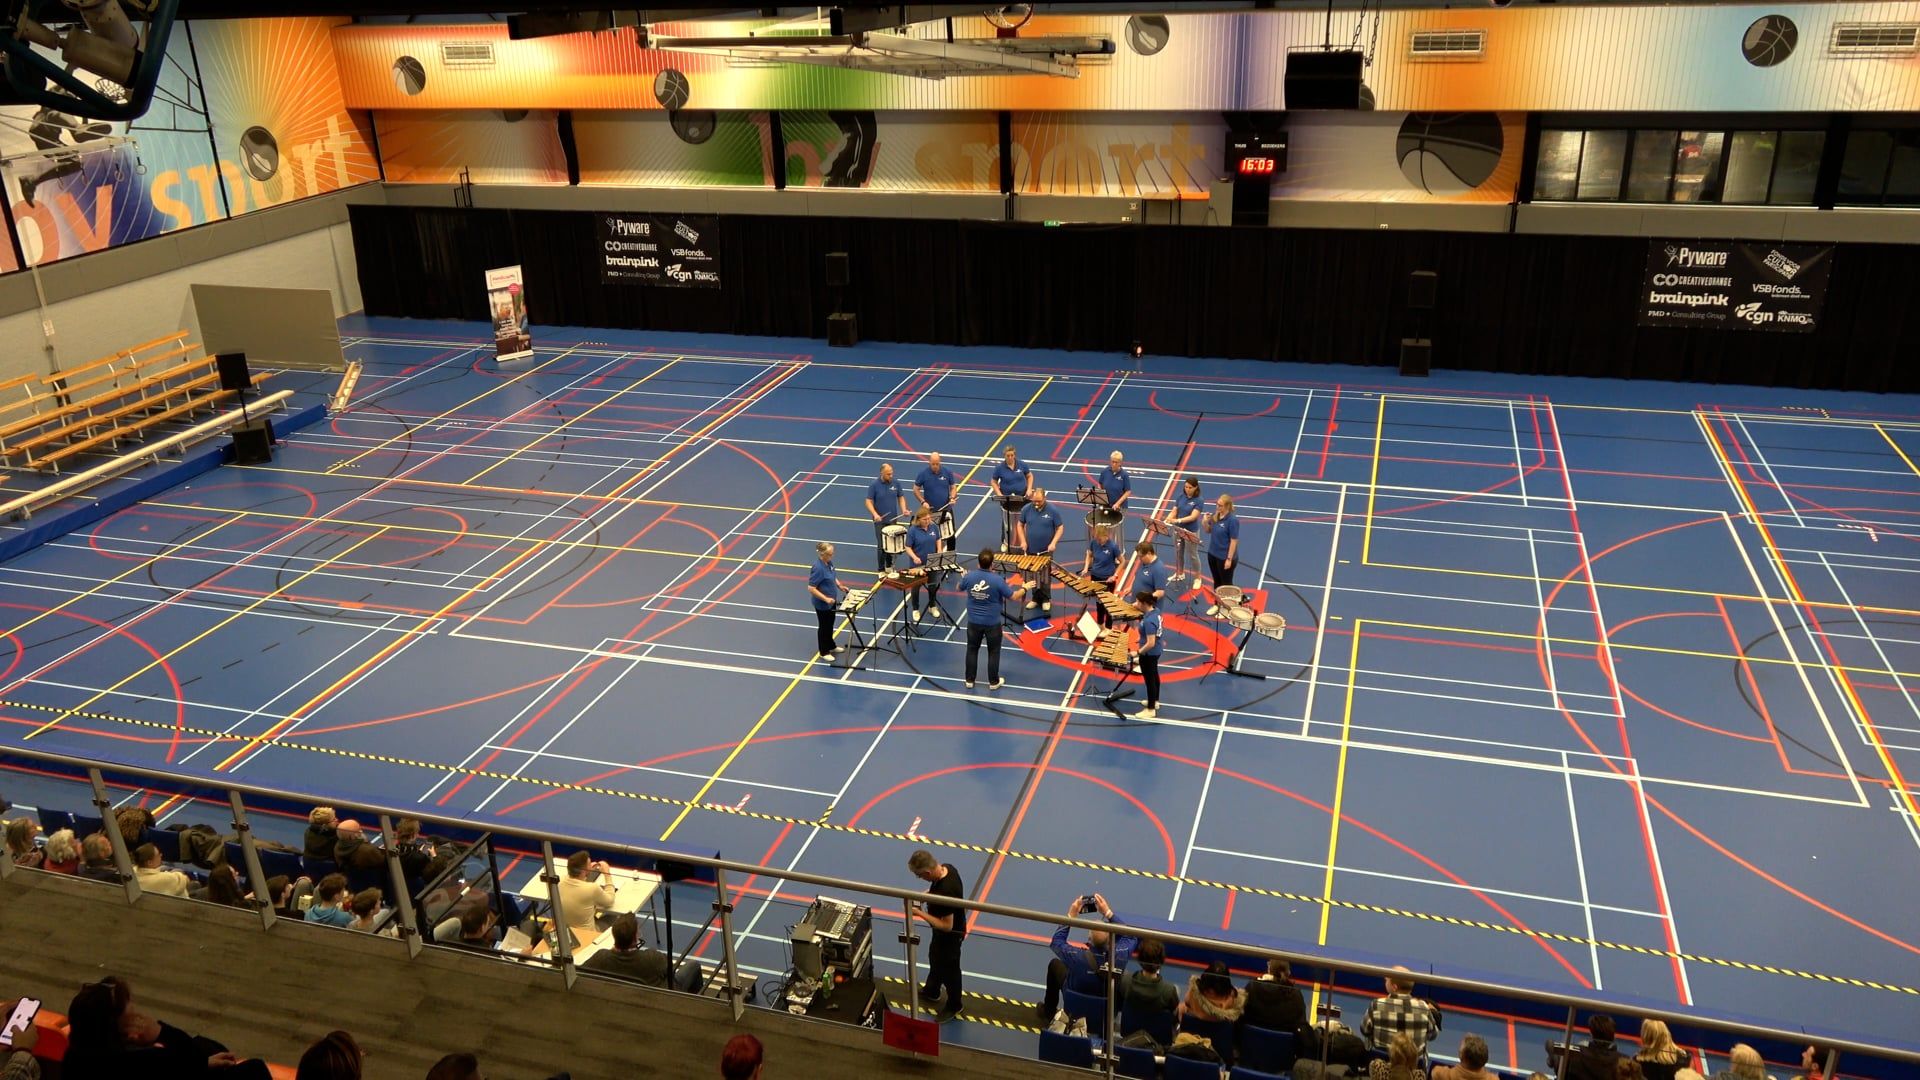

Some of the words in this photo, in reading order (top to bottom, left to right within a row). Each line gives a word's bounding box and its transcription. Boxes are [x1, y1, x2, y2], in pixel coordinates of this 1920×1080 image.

[1241, 159, 1274, 171] 16:03
[616, 219, 650, 236] Pyware
[606, 255, 660, 268] brainpink
[1679, 247, 1727, 267] Pyware
[673, 271, 693, 282] cgn
[1653, 273, 1679, 287] CO
[1649, 290, 1730, 307] brainpink
[1745, 311, 1774, 325] cgn
